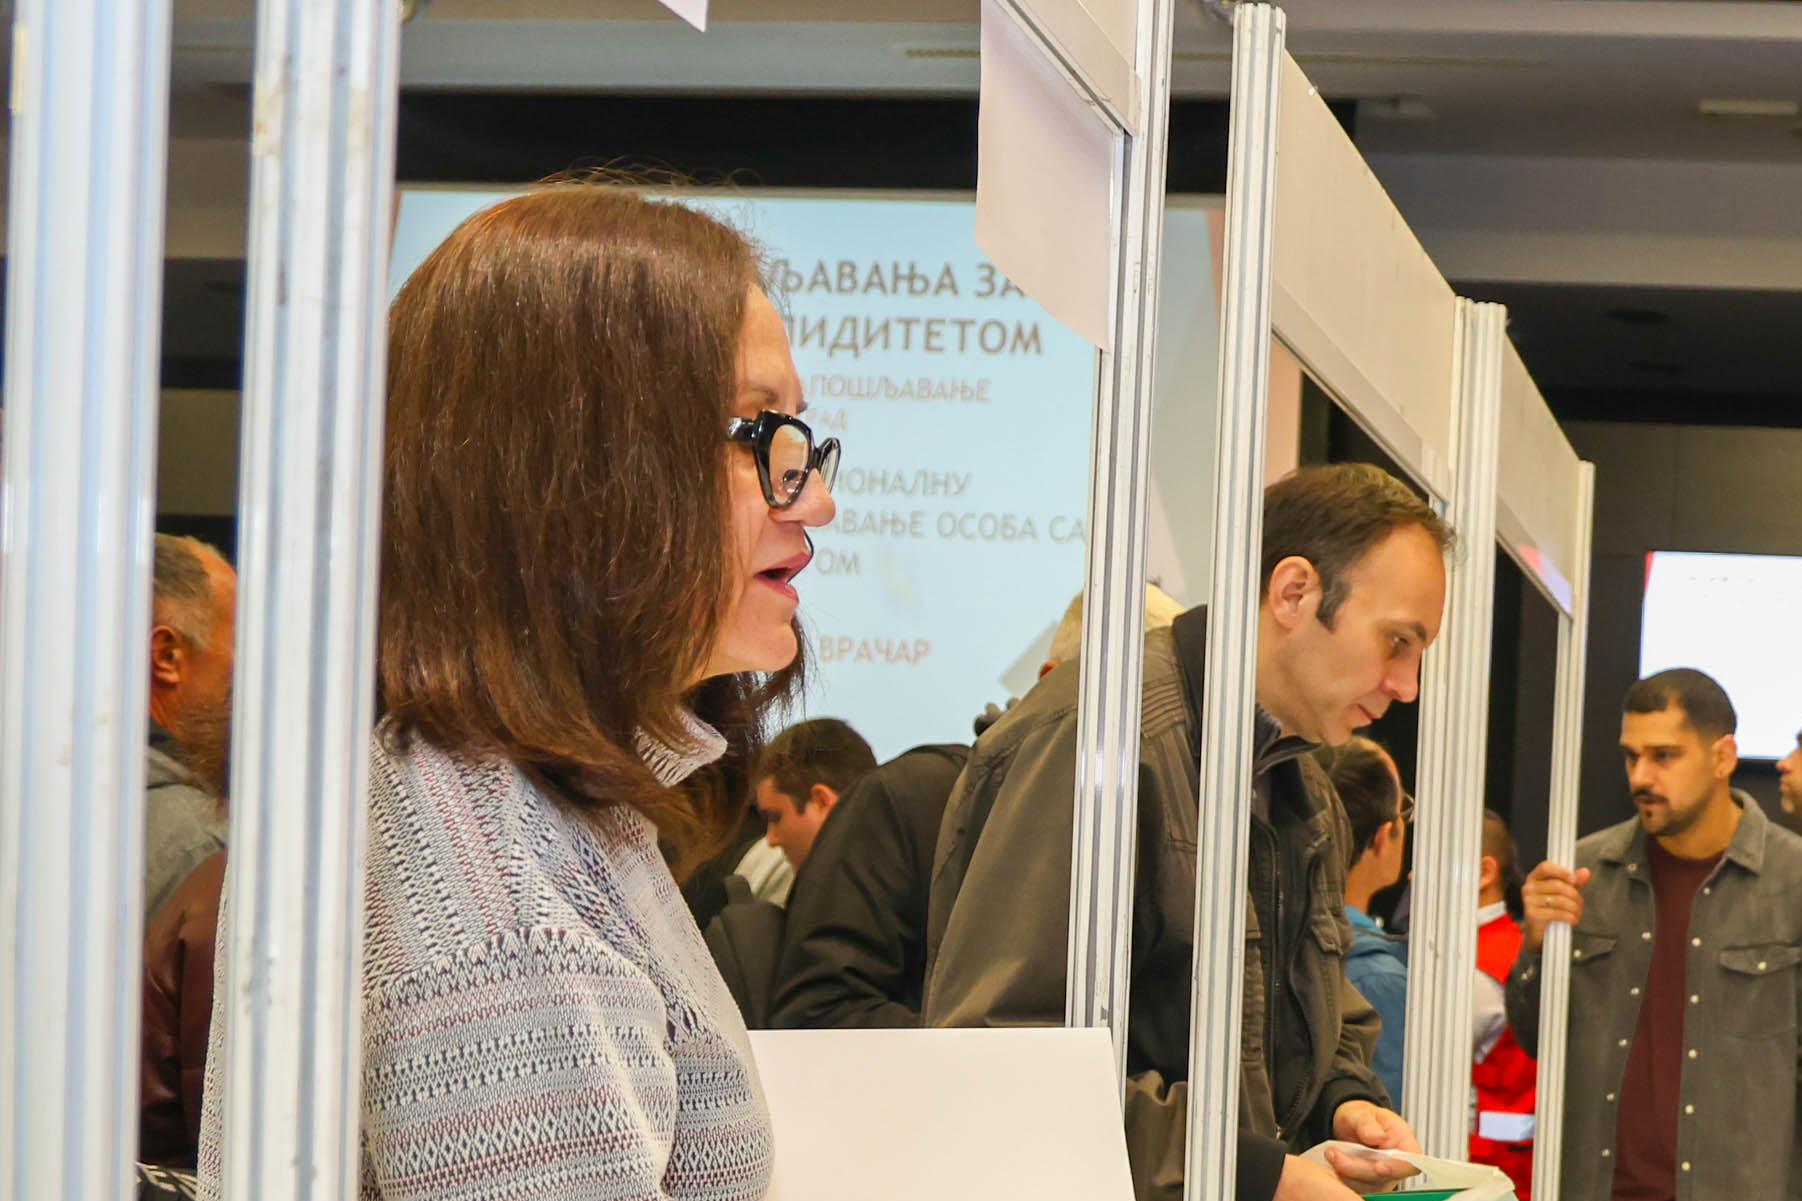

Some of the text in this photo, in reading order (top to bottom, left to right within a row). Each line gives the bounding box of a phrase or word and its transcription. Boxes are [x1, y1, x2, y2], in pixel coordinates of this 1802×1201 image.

[802, 374, 991, 402] ПОШЉАВАЊЕ
[936, 511, 1039, 542] ОСОБА
[818, 635, 933, 665] ВРАЧАР
